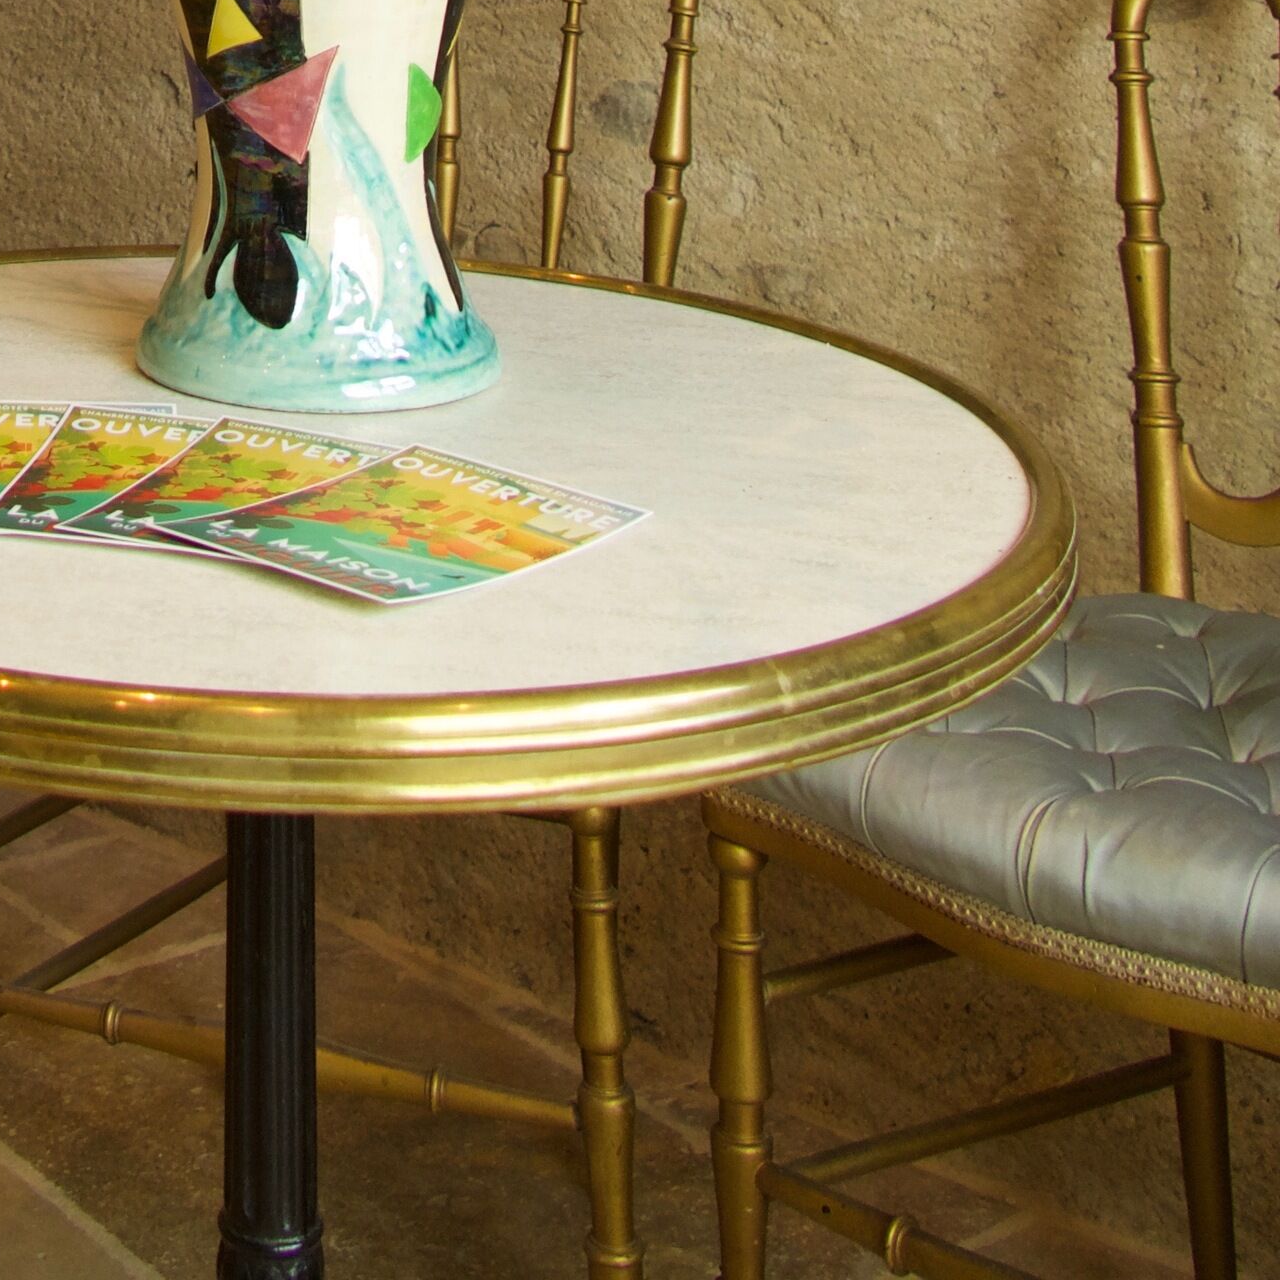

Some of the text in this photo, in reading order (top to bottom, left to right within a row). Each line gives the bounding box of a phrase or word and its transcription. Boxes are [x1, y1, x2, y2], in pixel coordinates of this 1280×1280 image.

[392, 456, 620, 531] OUVERTURE
[7, 504, 59, 520] LA
[104, 510, 155, 525] LA
[18, 517, 44, 525] DU
[209, 519, 431, 592] LA MAISON
